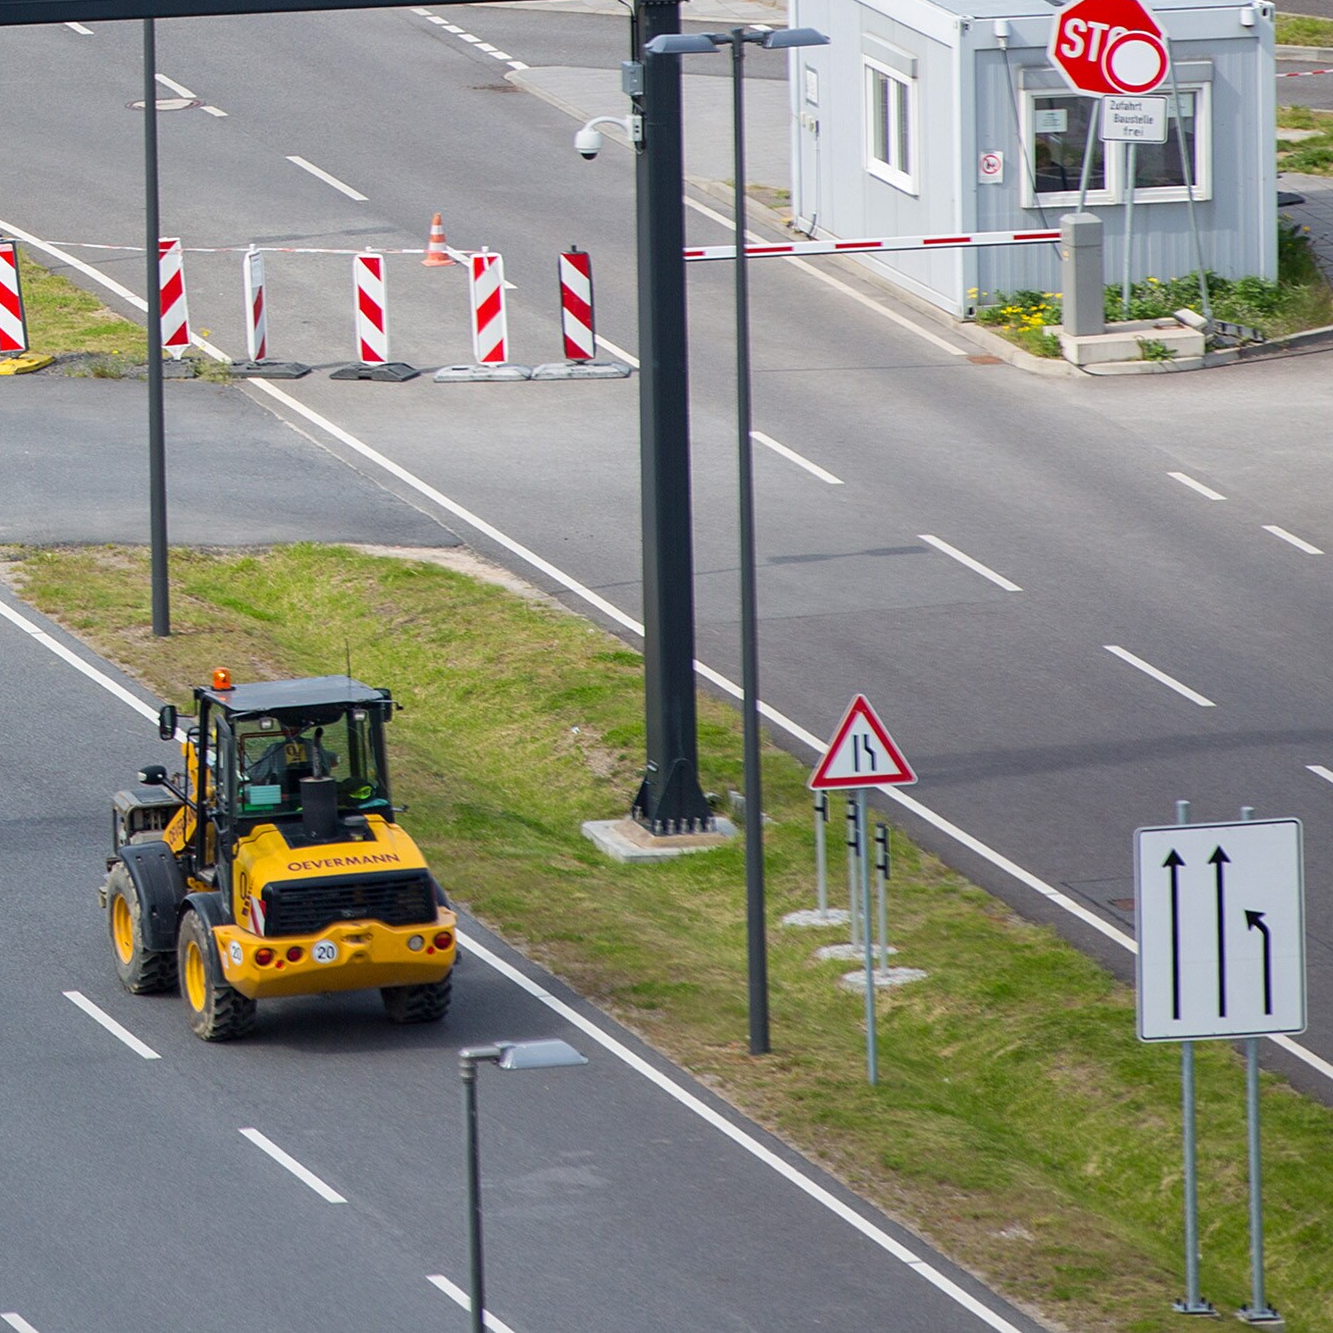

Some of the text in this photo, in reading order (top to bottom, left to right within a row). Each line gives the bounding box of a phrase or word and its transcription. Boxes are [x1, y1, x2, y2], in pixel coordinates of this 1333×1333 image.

[1110, 100, 1142, 111] Zufahrt
[1114, 113, 1154, 125] Baustelle
[1123, 126, 1144, 137] frei
[288, 853, 400, 872] OEVERMANN
[317, 946, 335, 960] 20
